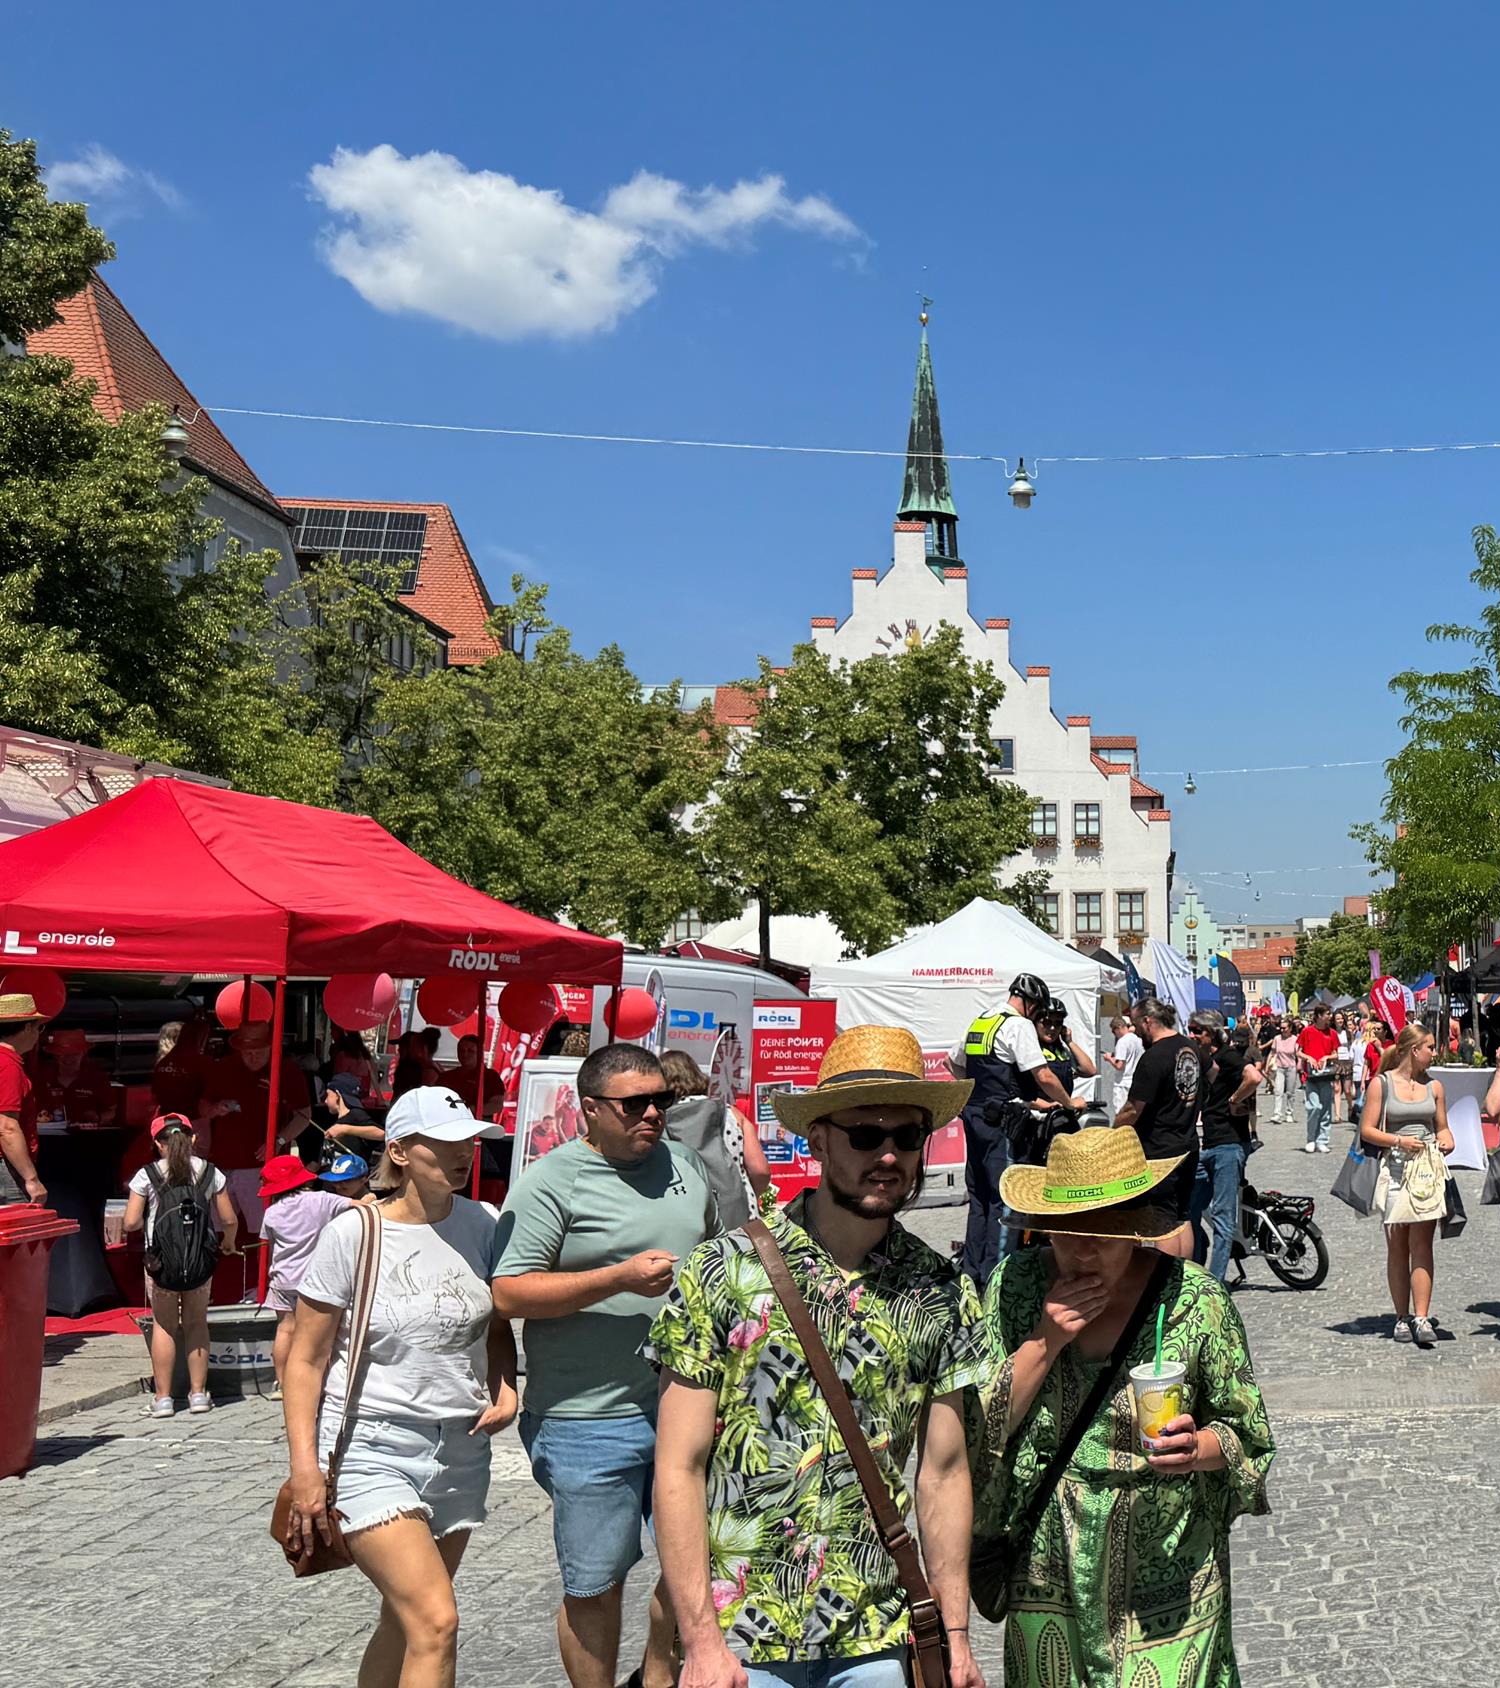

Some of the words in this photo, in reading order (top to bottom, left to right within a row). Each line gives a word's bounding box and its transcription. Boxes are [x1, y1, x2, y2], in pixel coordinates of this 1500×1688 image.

[0, 931, 37, 954] L
[38, 928, 115, 947] energie
[912, 967, 994, 977] HAMMERBACHER
[669, 1010, 720, 1029] DL
[668, 1030, 719, 1041] energi
[760, 1038, 786, 1047] DEINE
[787, 1037, 824, 1047] POWER
[760, 1050, 772, 1059] für
[793, 1052, 823, 1061] energie
[1067, 1187, 1104, 1199] BOCK
